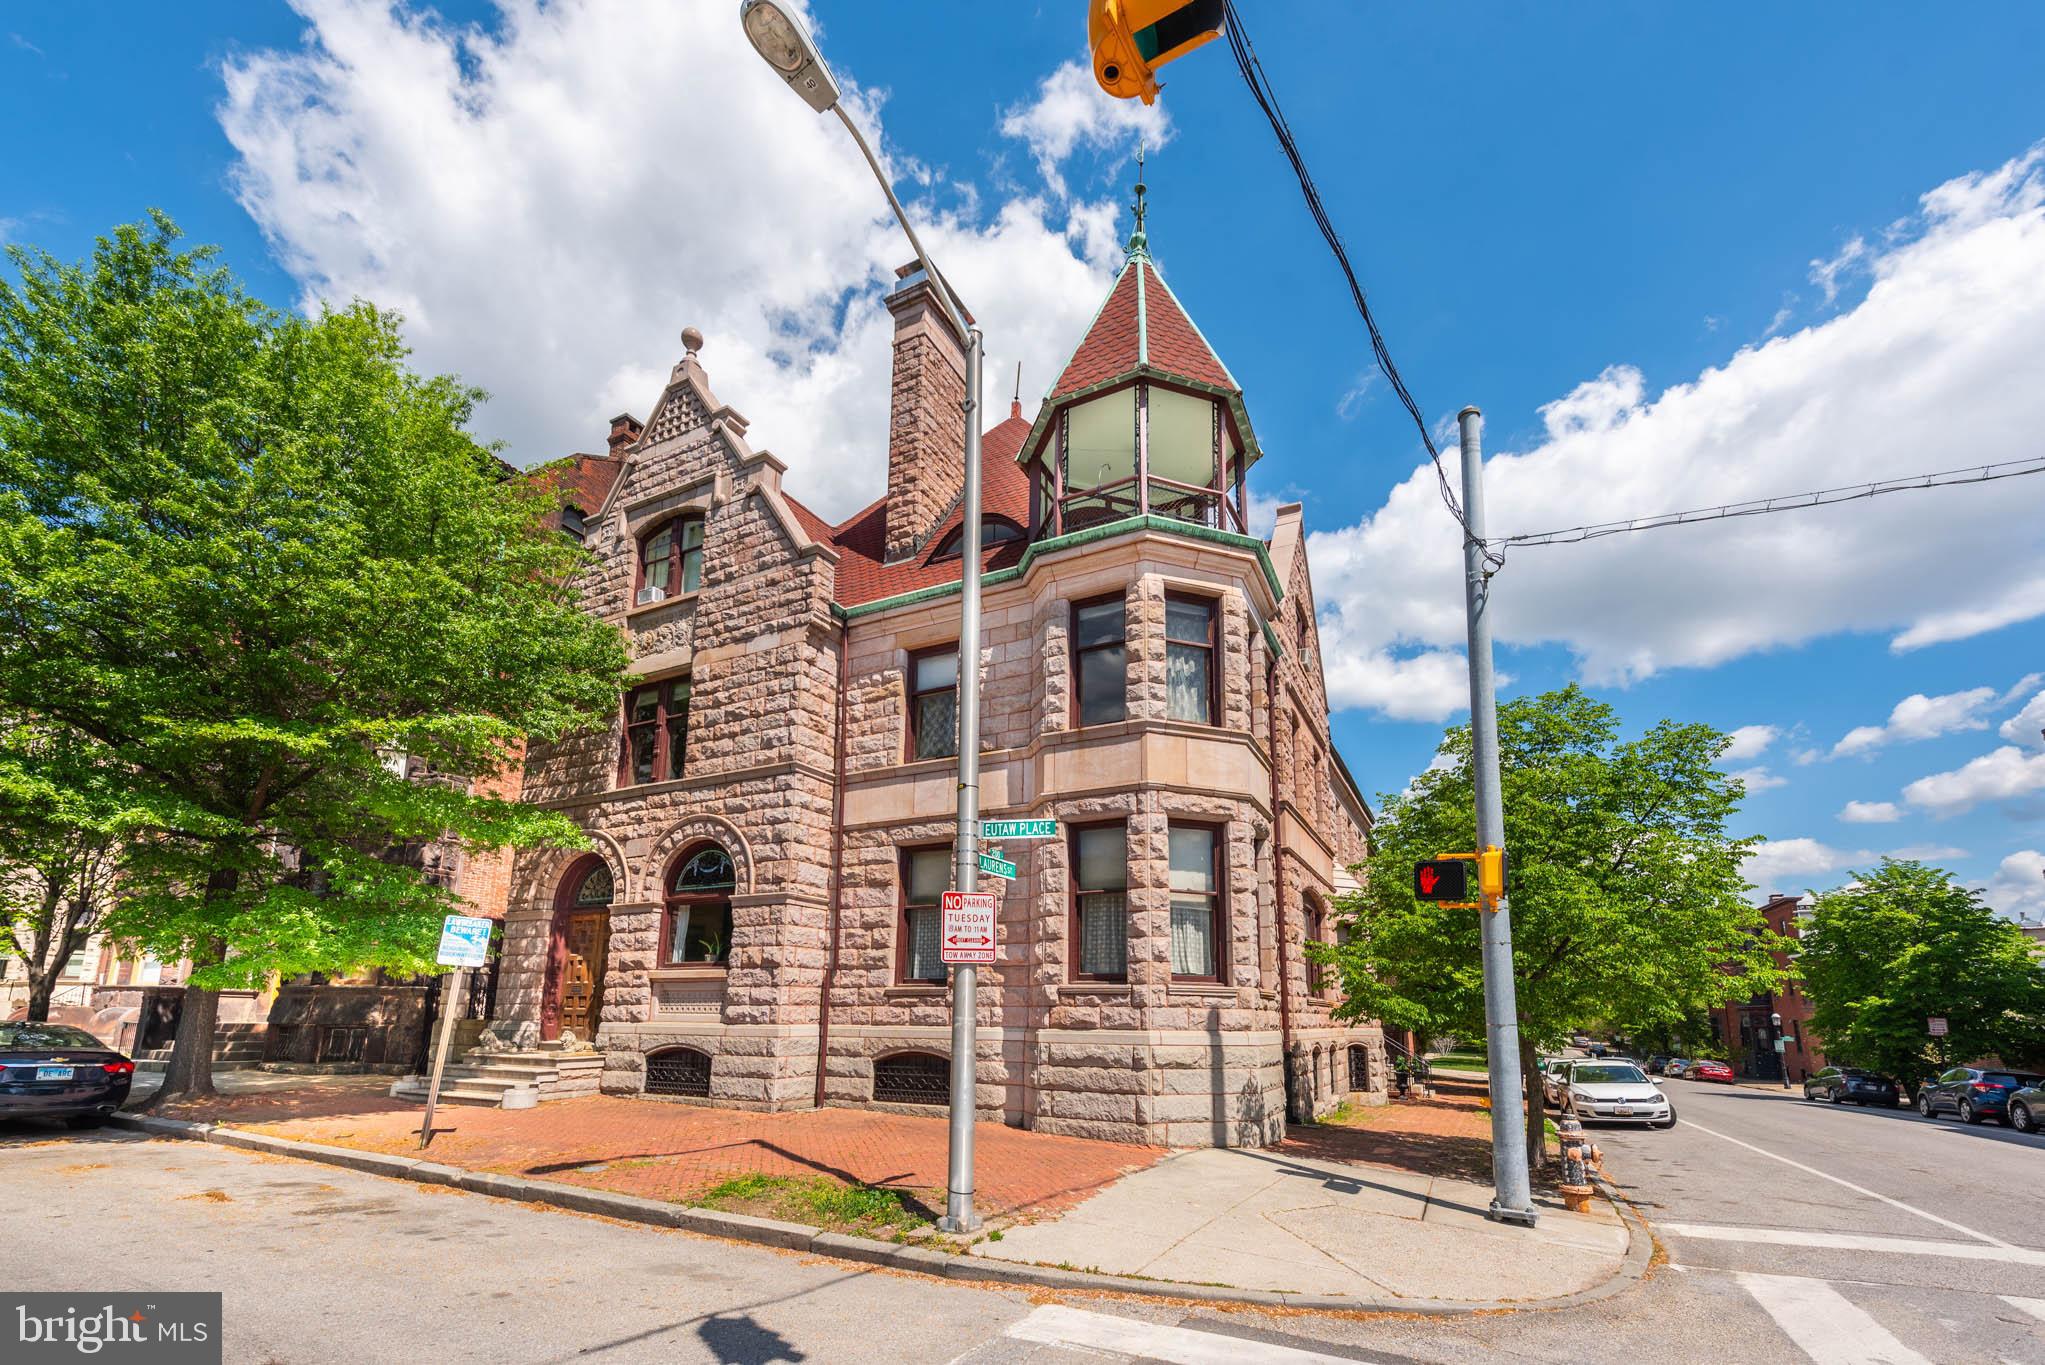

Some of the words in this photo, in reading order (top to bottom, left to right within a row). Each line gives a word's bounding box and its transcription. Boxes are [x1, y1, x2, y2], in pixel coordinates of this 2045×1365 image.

[985, 822, 1017, 836] EUTAW
[1019, 821, 1051, 835] PLACE
[979, 855, 1008, 875] LAURENS
[945, 896, 962, 909] NO
[964, 897, 993, 909] PARKING
[948, 913, 991, 923] TUESDAY
[945, 951, 958, 959] TOW
[960, 951, 977, 960] AWAY
[978, 951, 993, 960] ZONE
